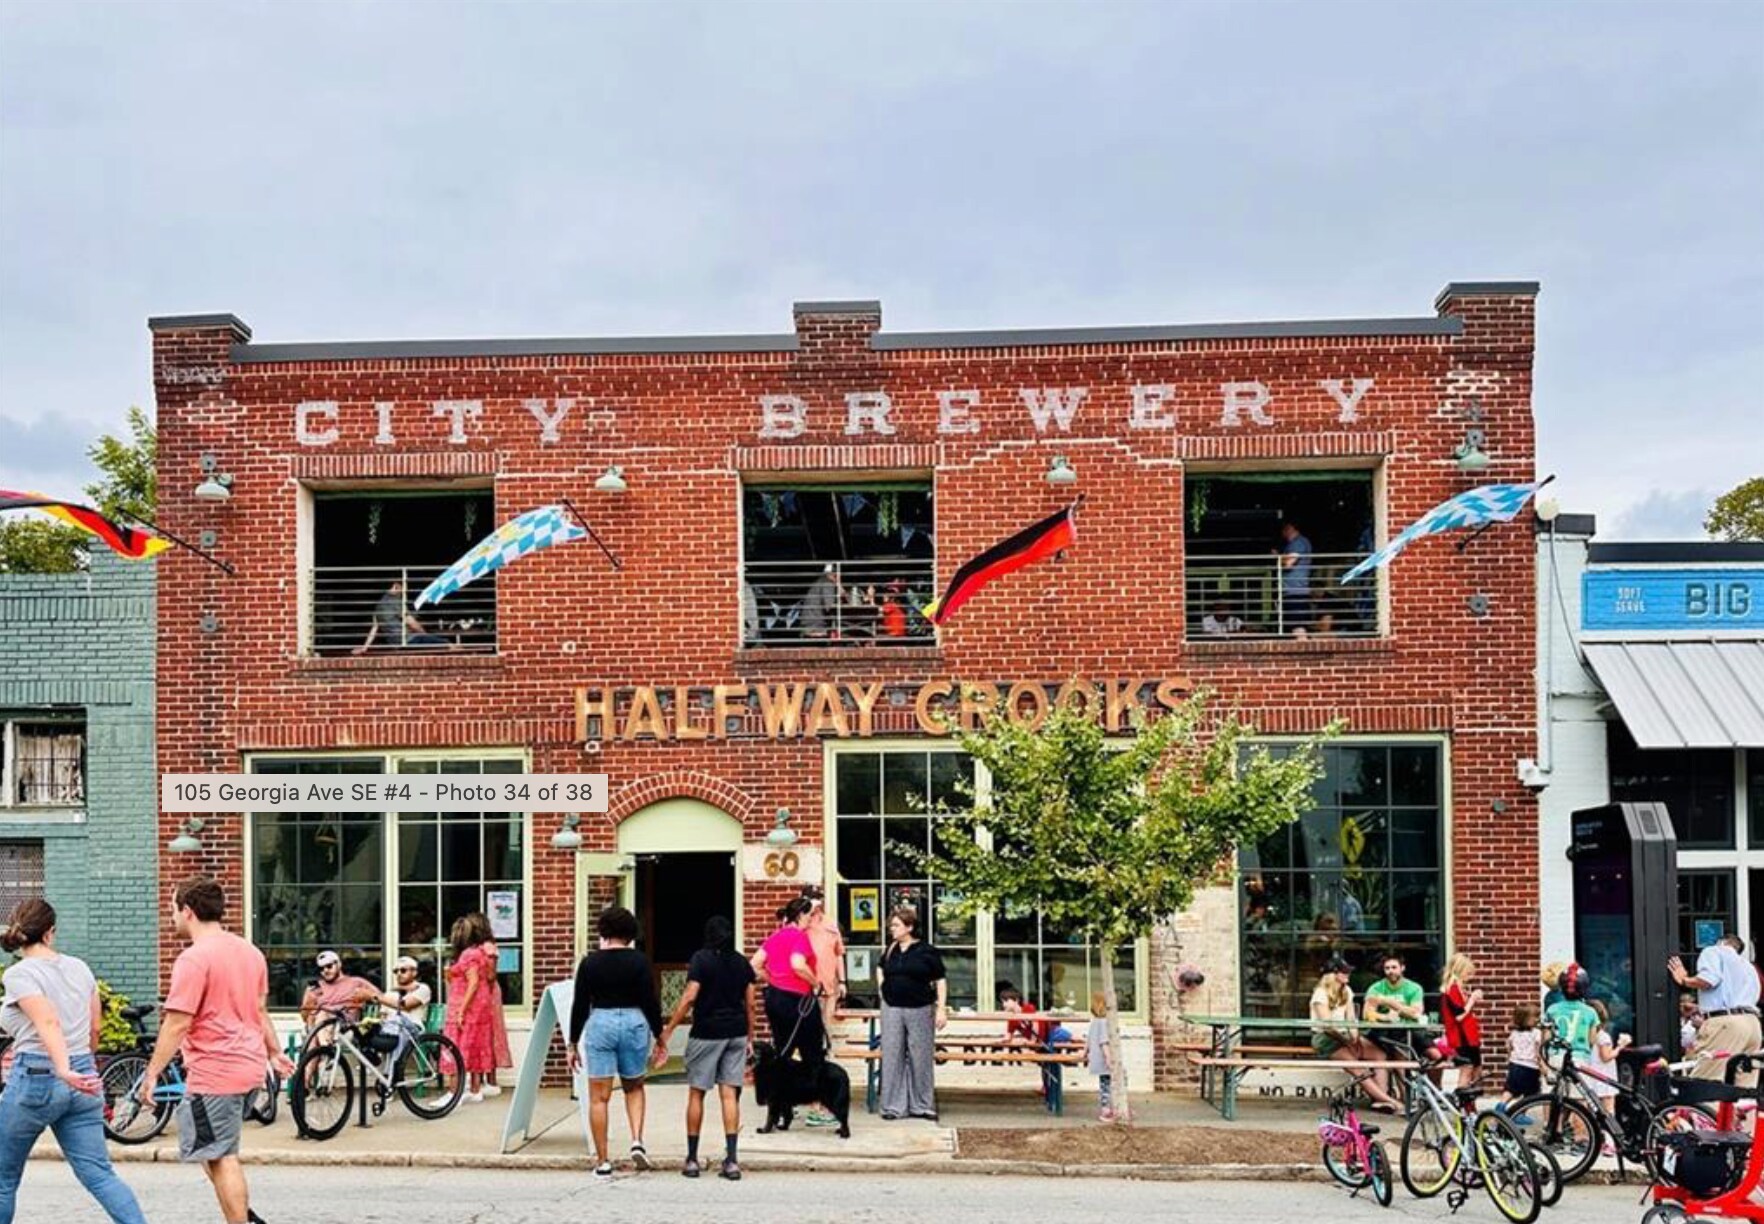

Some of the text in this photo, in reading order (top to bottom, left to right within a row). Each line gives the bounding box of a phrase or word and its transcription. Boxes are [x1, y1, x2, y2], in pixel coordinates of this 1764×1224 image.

[295, 378, 1375, 446] CITY BREWERY
[1684, 582, 1753, 618] BIG
[574, 681, 884, 741] HALFWAY
